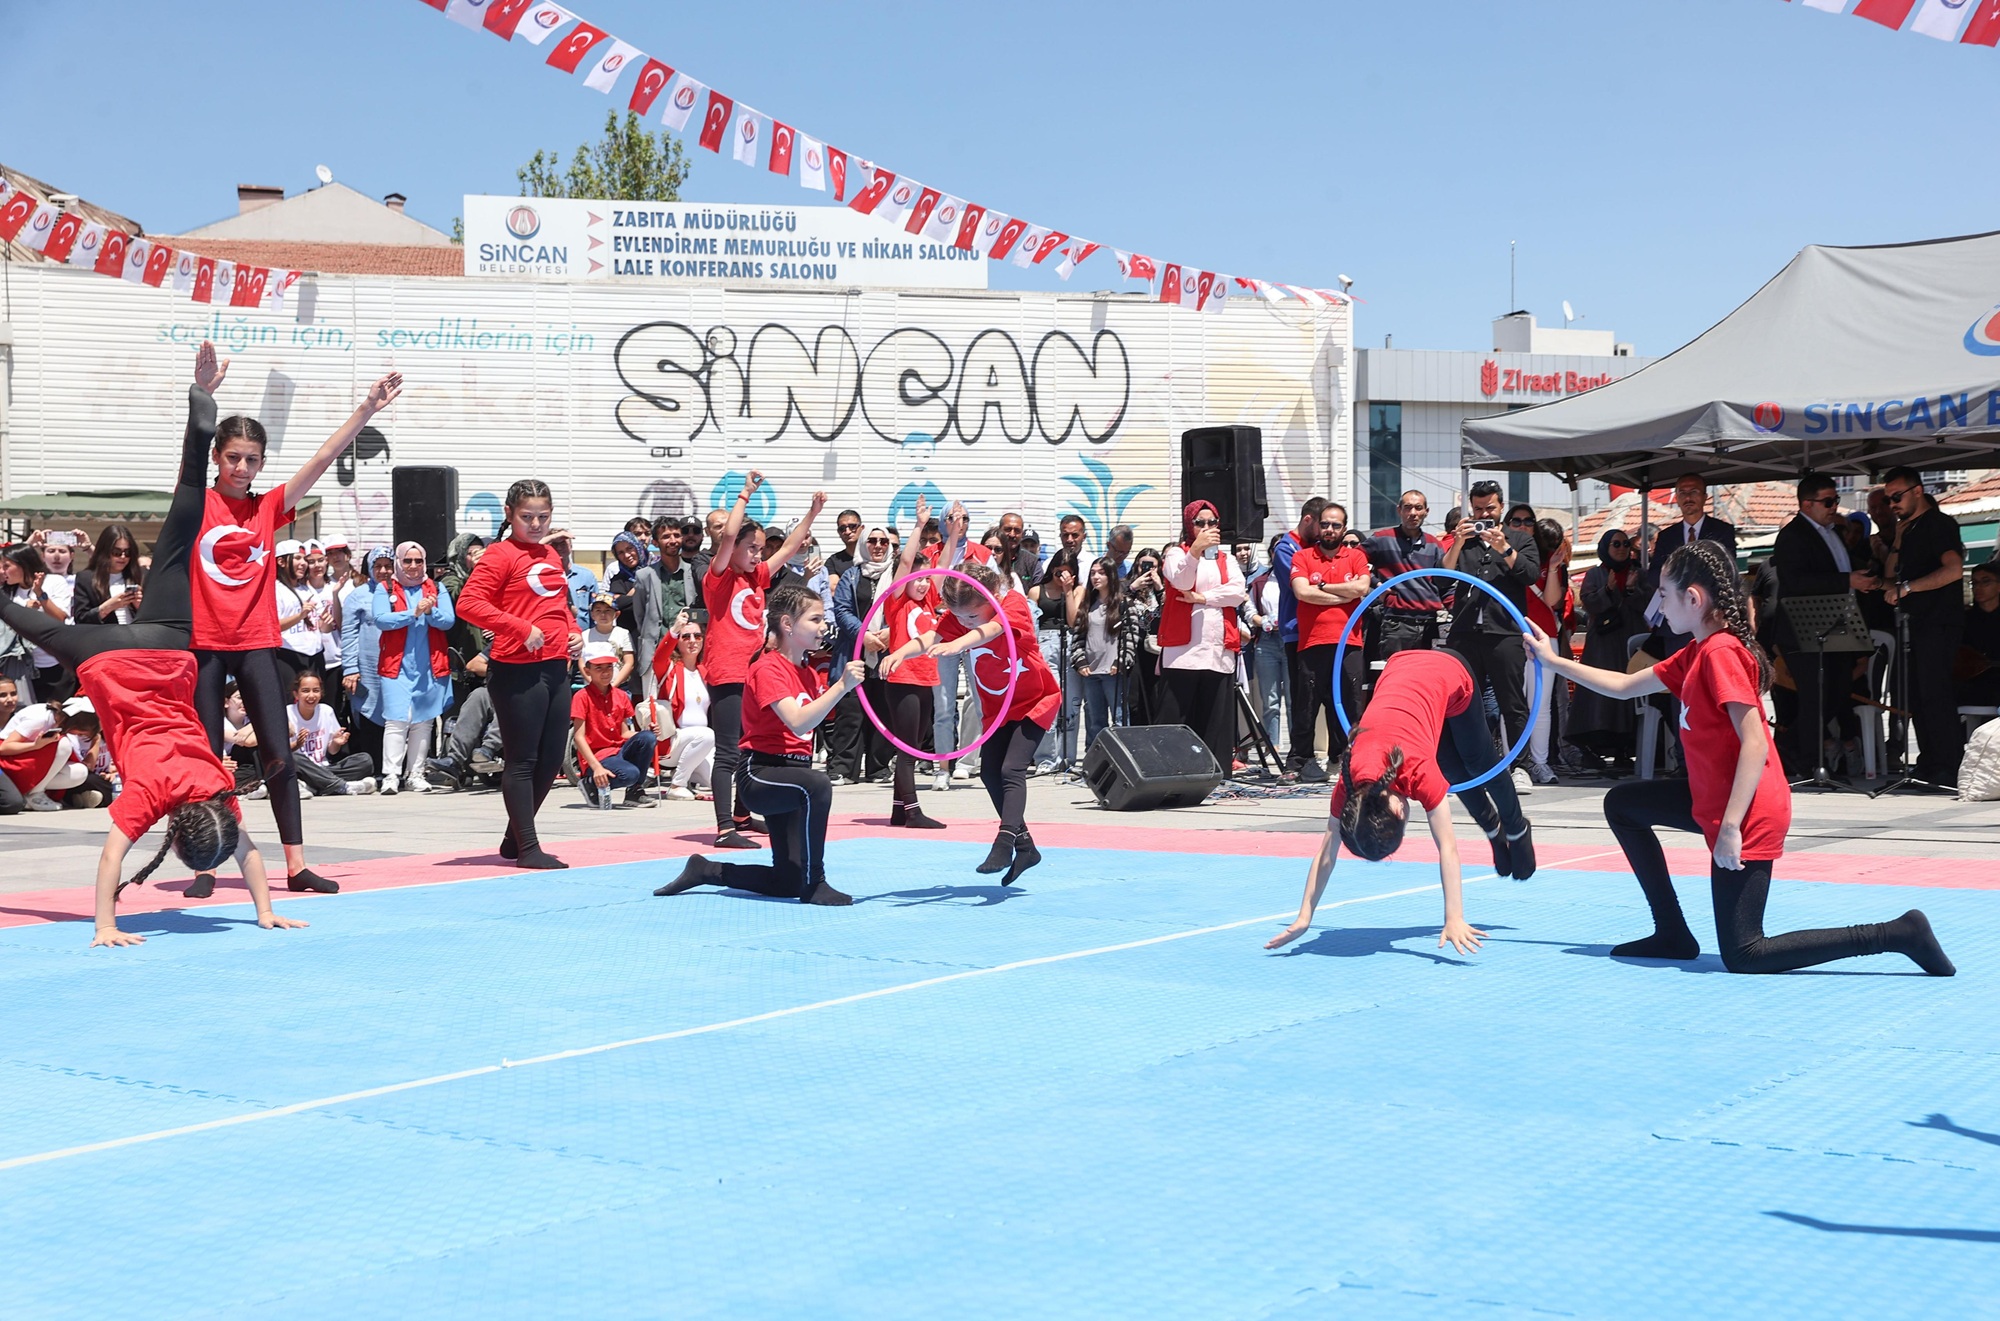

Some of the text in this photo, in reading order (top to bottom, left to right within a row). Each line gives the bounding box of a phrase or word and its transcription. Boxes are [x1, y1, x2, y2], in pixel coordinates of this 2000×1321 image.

[613, 209, 797, 232] ZABITA MÜDÜRLÜĞÜ
[613, 232, 980, 261] EVLENDİRME MEMURLUĞU VE NİKAH SALONU
[614, 259, 837, 280] LALE KONFERANS SALONU
[376, 317, 534, 350] sevdiklerin
[545, 324, 595, 355] için
[1503, 368, 1562, 393] Ziraat
